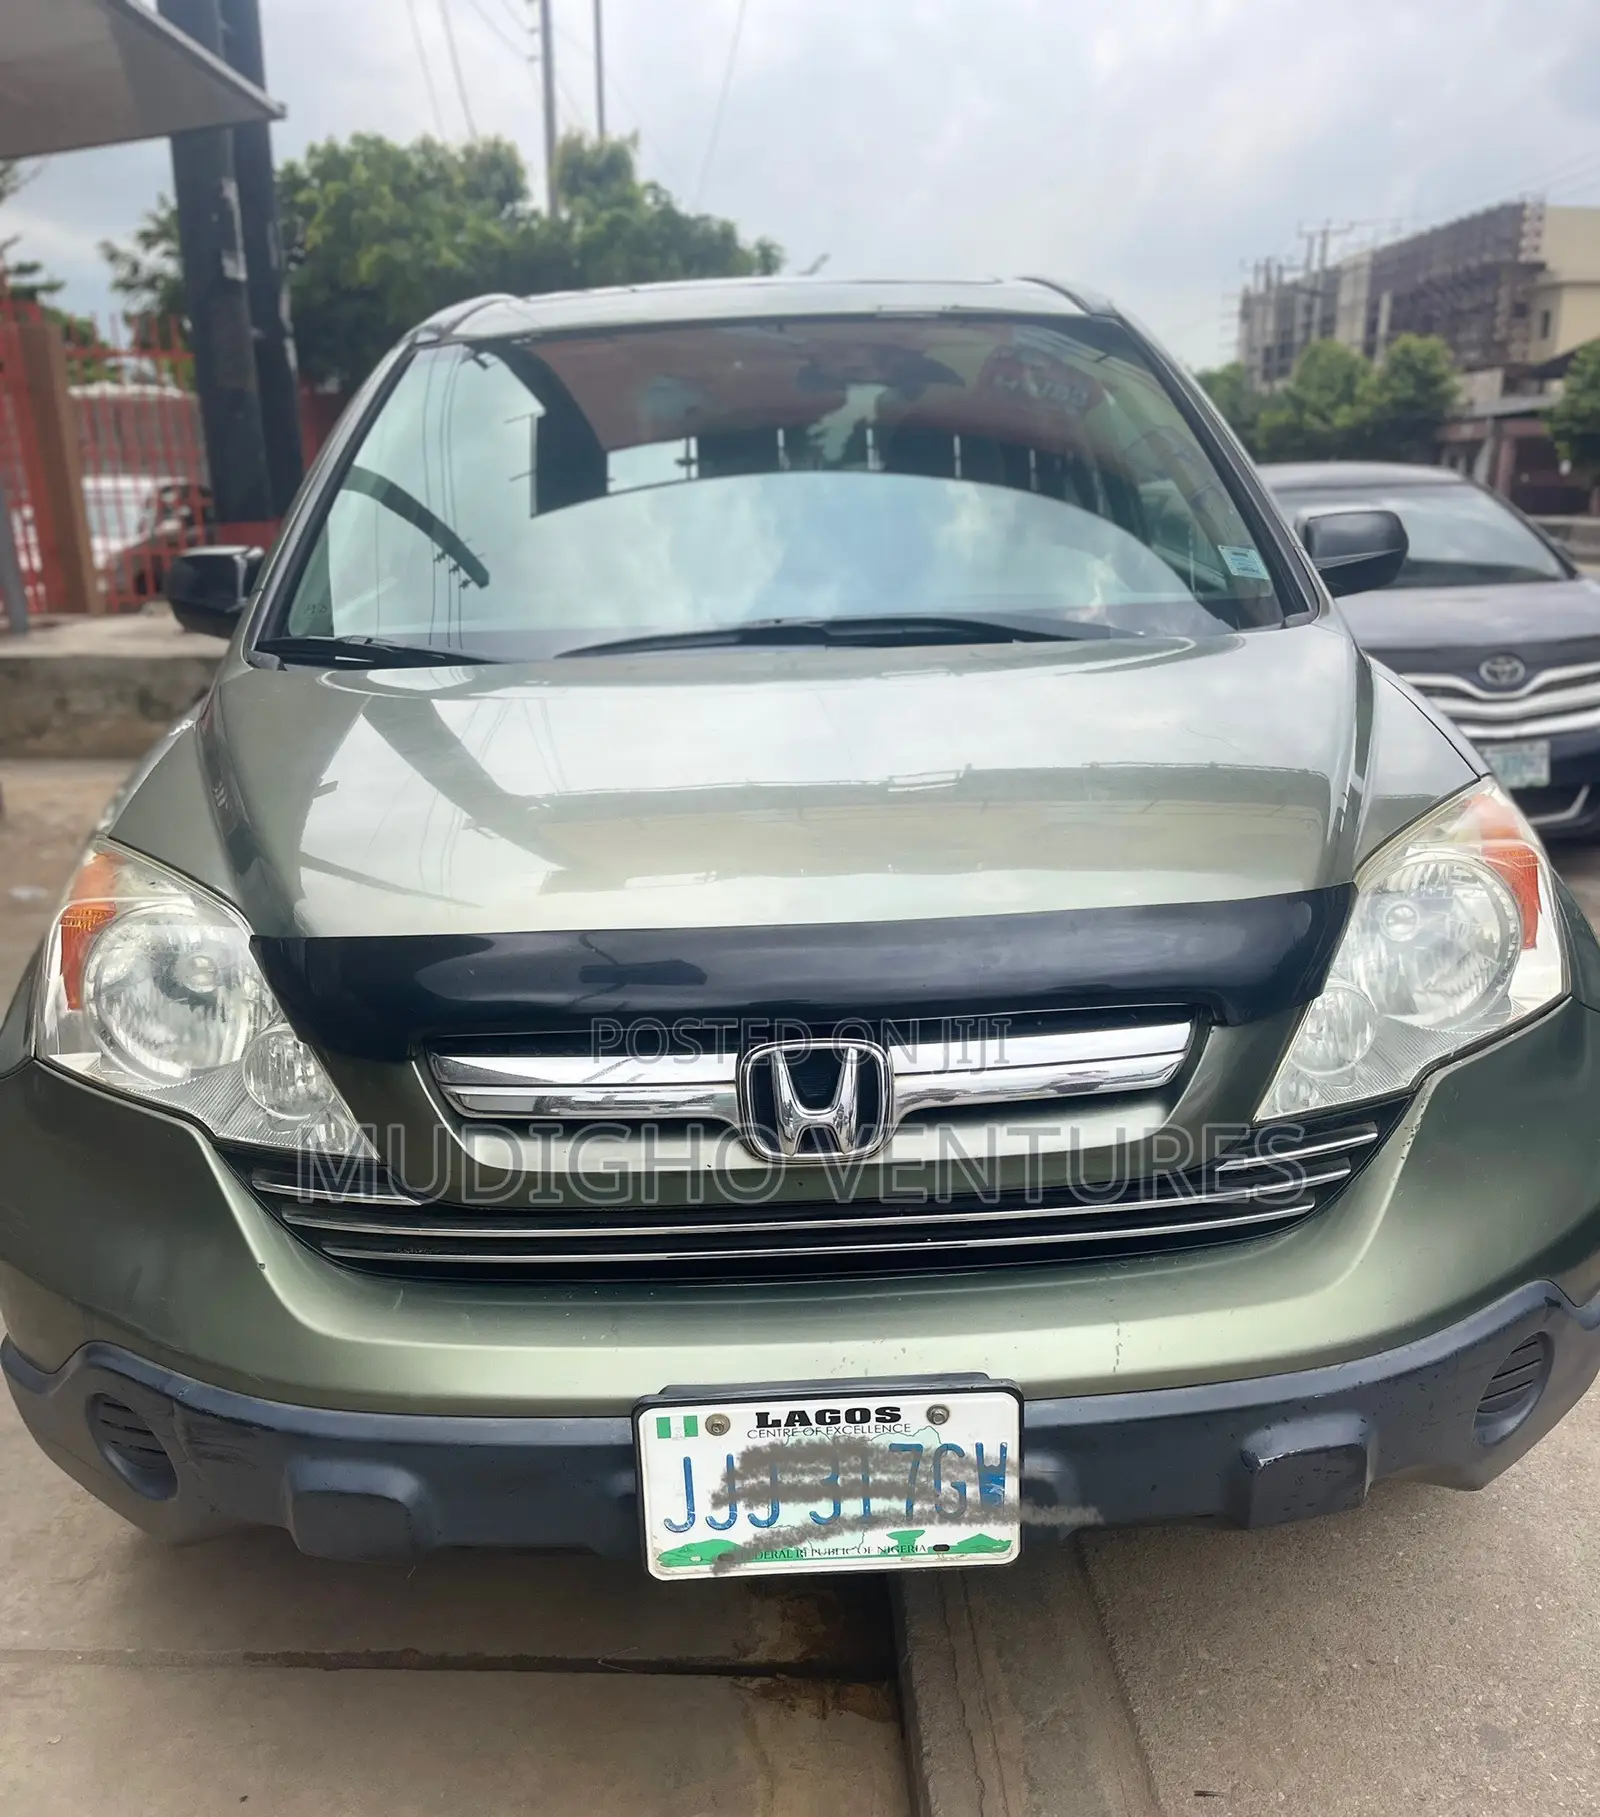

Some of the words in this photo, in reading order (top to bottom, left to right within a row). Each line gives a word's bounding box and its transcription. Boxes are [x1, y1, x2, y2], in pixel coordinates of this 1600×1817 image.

[755, 1406, 902, 1429] LAGOS
[747, 1428, 799, 1440] CENTRE
[802, 1426, 821, 1437] OF
[826, 1423, 912, 1436] EXCELLENCE
[877, 1544, 928, 1555] NIGERIA
